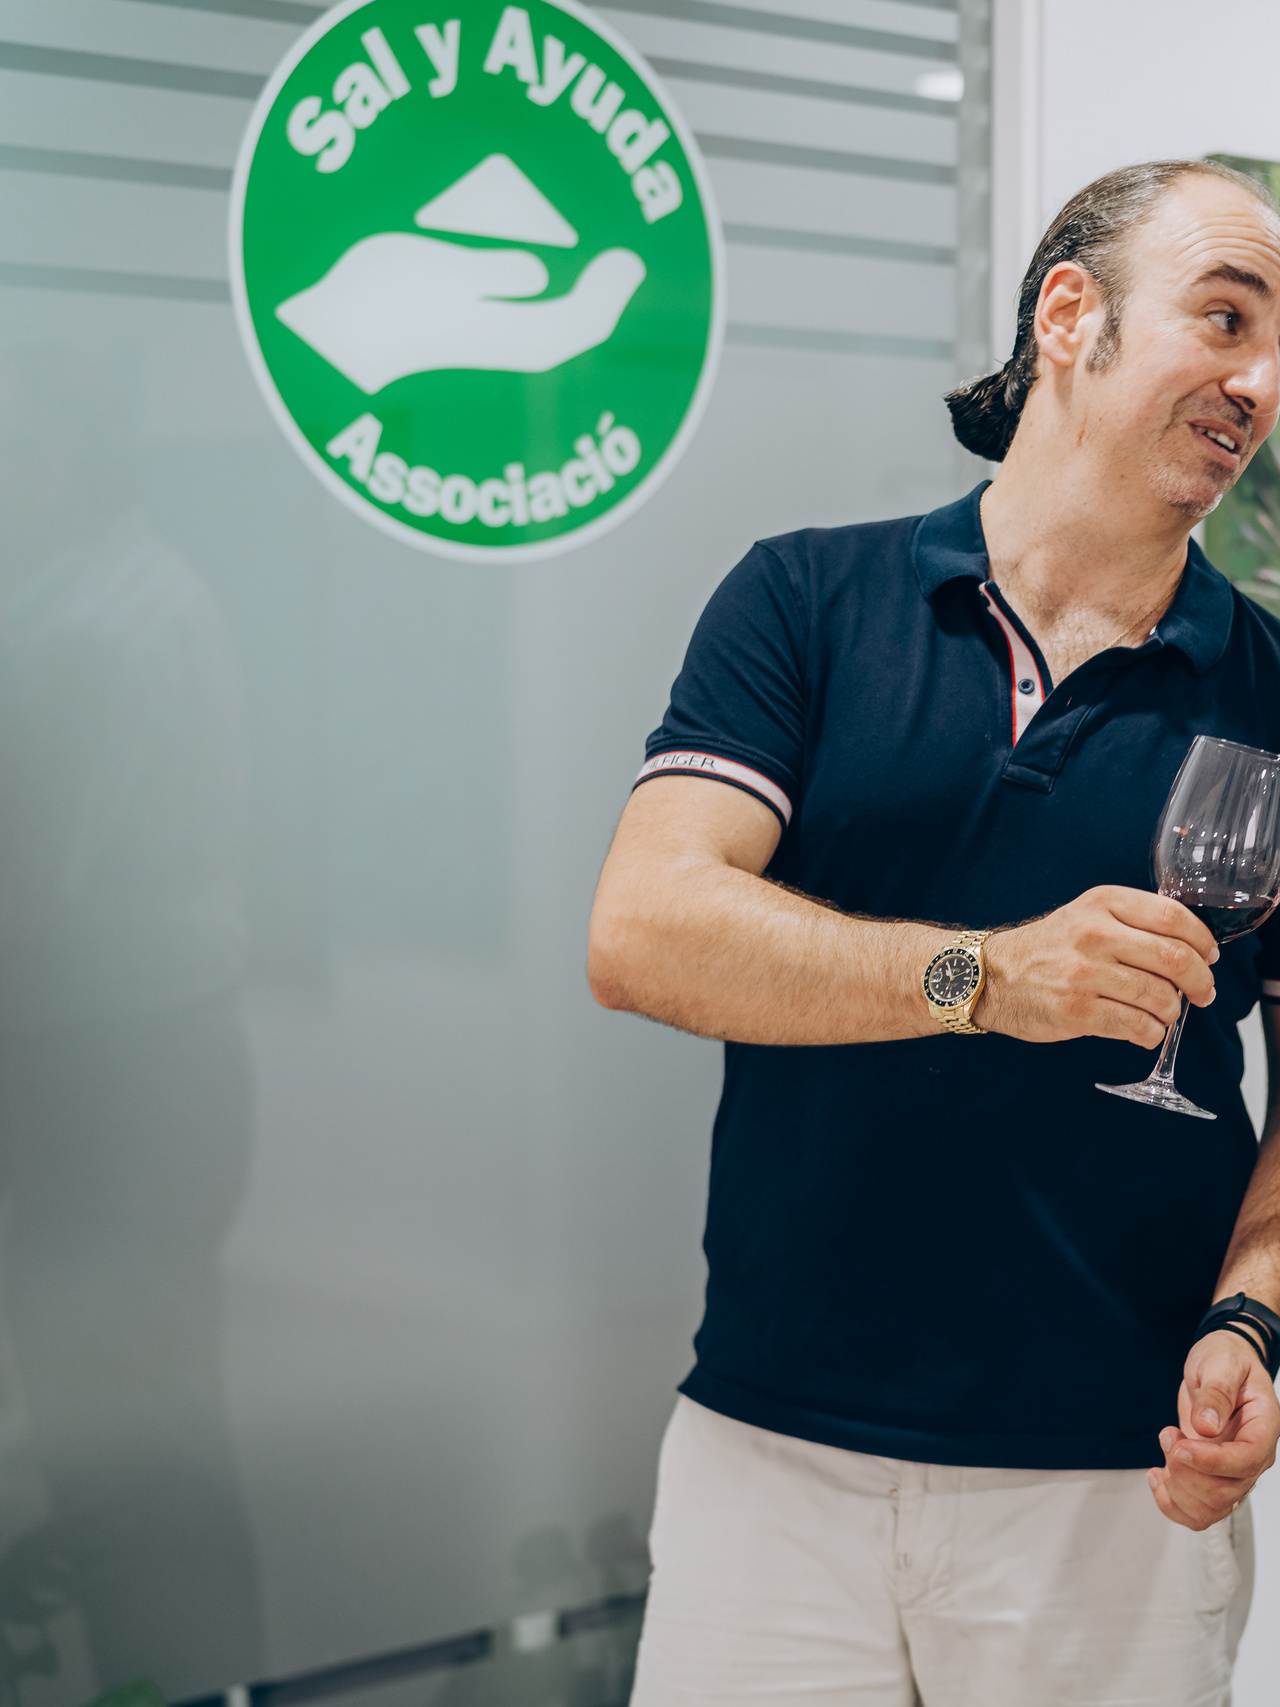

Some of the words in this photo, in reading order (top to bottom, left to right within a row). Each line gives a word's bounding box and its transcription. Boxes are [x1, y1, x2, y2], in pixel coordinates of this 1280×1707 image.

[286, 26, 411, 174] Sal
[414, 19, 461, 98] y
[483, 5, 684, 224] Ayuda
[326, 411, 641, 528] Associació
